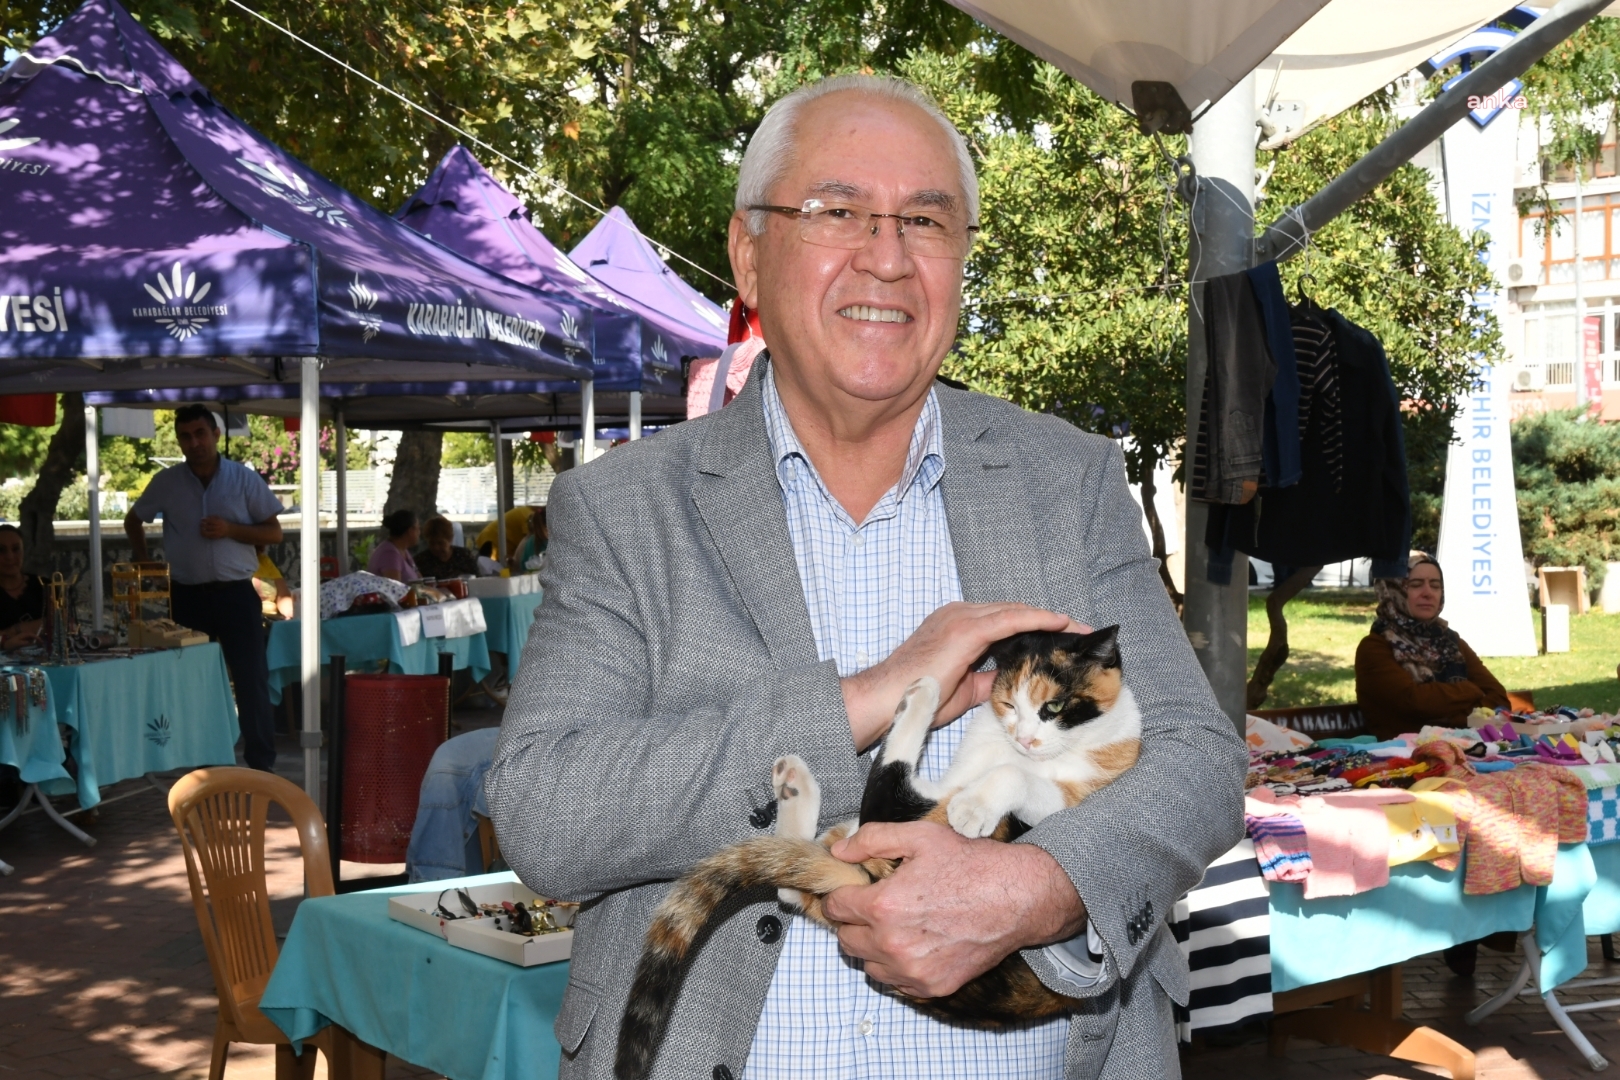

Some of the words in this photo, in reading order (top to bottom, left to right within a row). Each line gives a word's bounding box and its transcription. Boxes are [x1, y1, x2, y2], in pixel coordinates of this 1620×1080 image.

[1471, 193, 1497, 268] İZR
[132, 305, 182, 317] KARABAĞLAR
[184, 303, 228, 316] BELEDİYESİ
[407, 298, 486, 339] KARABAĞLAR
[486, 310, 546, 350] BELEDİYESİ
[1472, 449, 1498, 595] BELEDİYESİ
